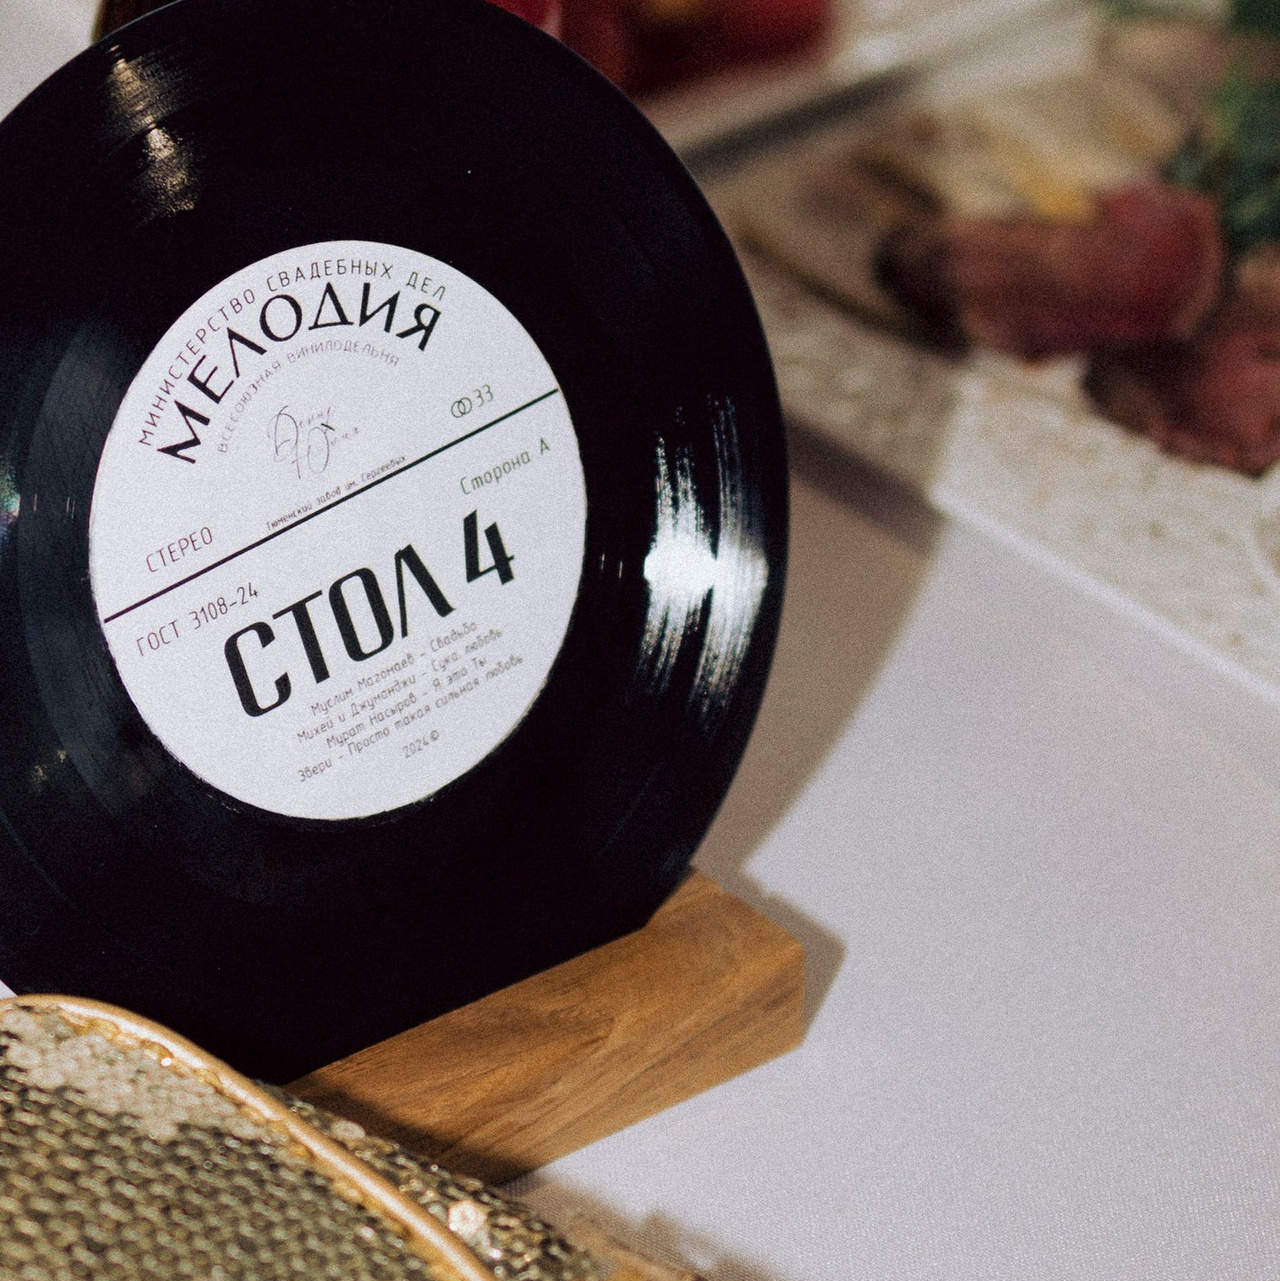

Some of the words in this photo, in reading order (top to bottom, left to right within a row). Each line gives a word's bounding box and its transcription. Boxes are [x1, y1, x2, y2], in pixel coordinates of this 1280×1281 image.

[139, 289, 255, 446] МИНИСТЕРСТВО
[267, 258, 393, 292] СВАДЕБНЫХ
[406, 272, 446, 301] ДЕЛ
[157, 282, 441, 464] МЕЛОДИЯ
[217, 360, 281, 454] ВСЕСОЮЗНАЯ
[287, 340, 400, 367] ВИНИЛОДЕЛЬНЯ
[317, 486, 342, 506] завод
[460, 451, 531, 495] Сторона
[145, 526, 213, 573] СТЕРЕО
[136, 620, 180, 656] ГОСТ
[189, 582, 259, 630] 3108-24
[224, 543, 456, 718] СТОЛ
[463, 509, 515, 586] 4
[297, 715, 334, 743] Михей
[337, 713, 346, 723] и
[350, 674, 417, 718] Джуманджи
[310, 688, 355, 716] Муслим
[357, 653, 415, 690] Магомаев
[430, 622, 478, 652] Свадьба
[326, 722, 366, 749] Мурат
[368, 692, 417, 726] Насыров
[432, 677, 441, 690] Я
[446, 667, 468, 686] это
[298, 758, 333, 783] Звери
[347, 726, 391, 756] Просто
[394, 704, 431, 731] такая
[435, 678, 481, 709] сильная
